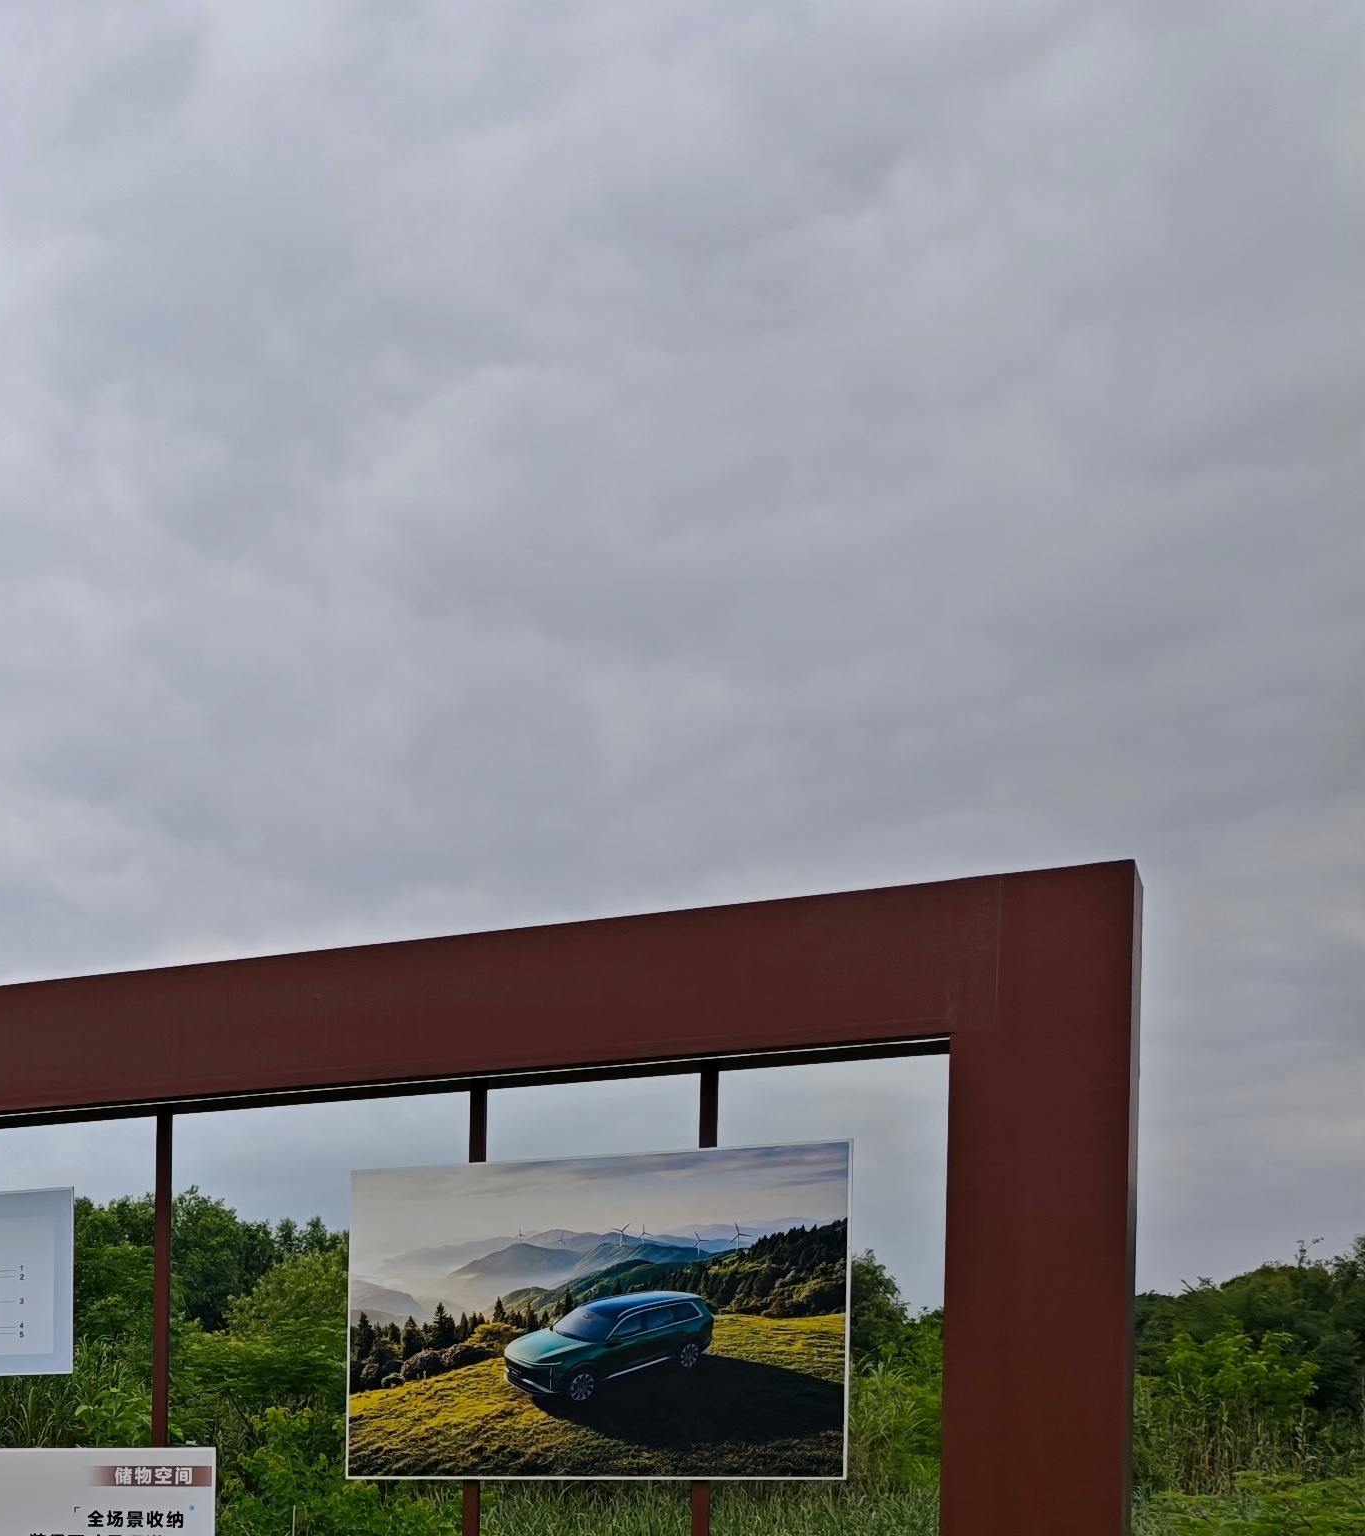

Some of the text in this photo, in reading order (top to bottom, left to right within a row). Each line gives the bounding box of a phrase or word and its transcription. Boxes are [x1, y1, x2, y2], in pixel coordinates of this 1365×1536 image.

[19, 1273, 25, 1281] 2
[19, 1297, 25, 1305] 3
[19, 1321, 25, 1329] 4
[19, 1330, 25, 1338] 5
[114, 1466, 193, 1485] 储物空间
[87, 1510, 184, 1529] 全场景收纳
